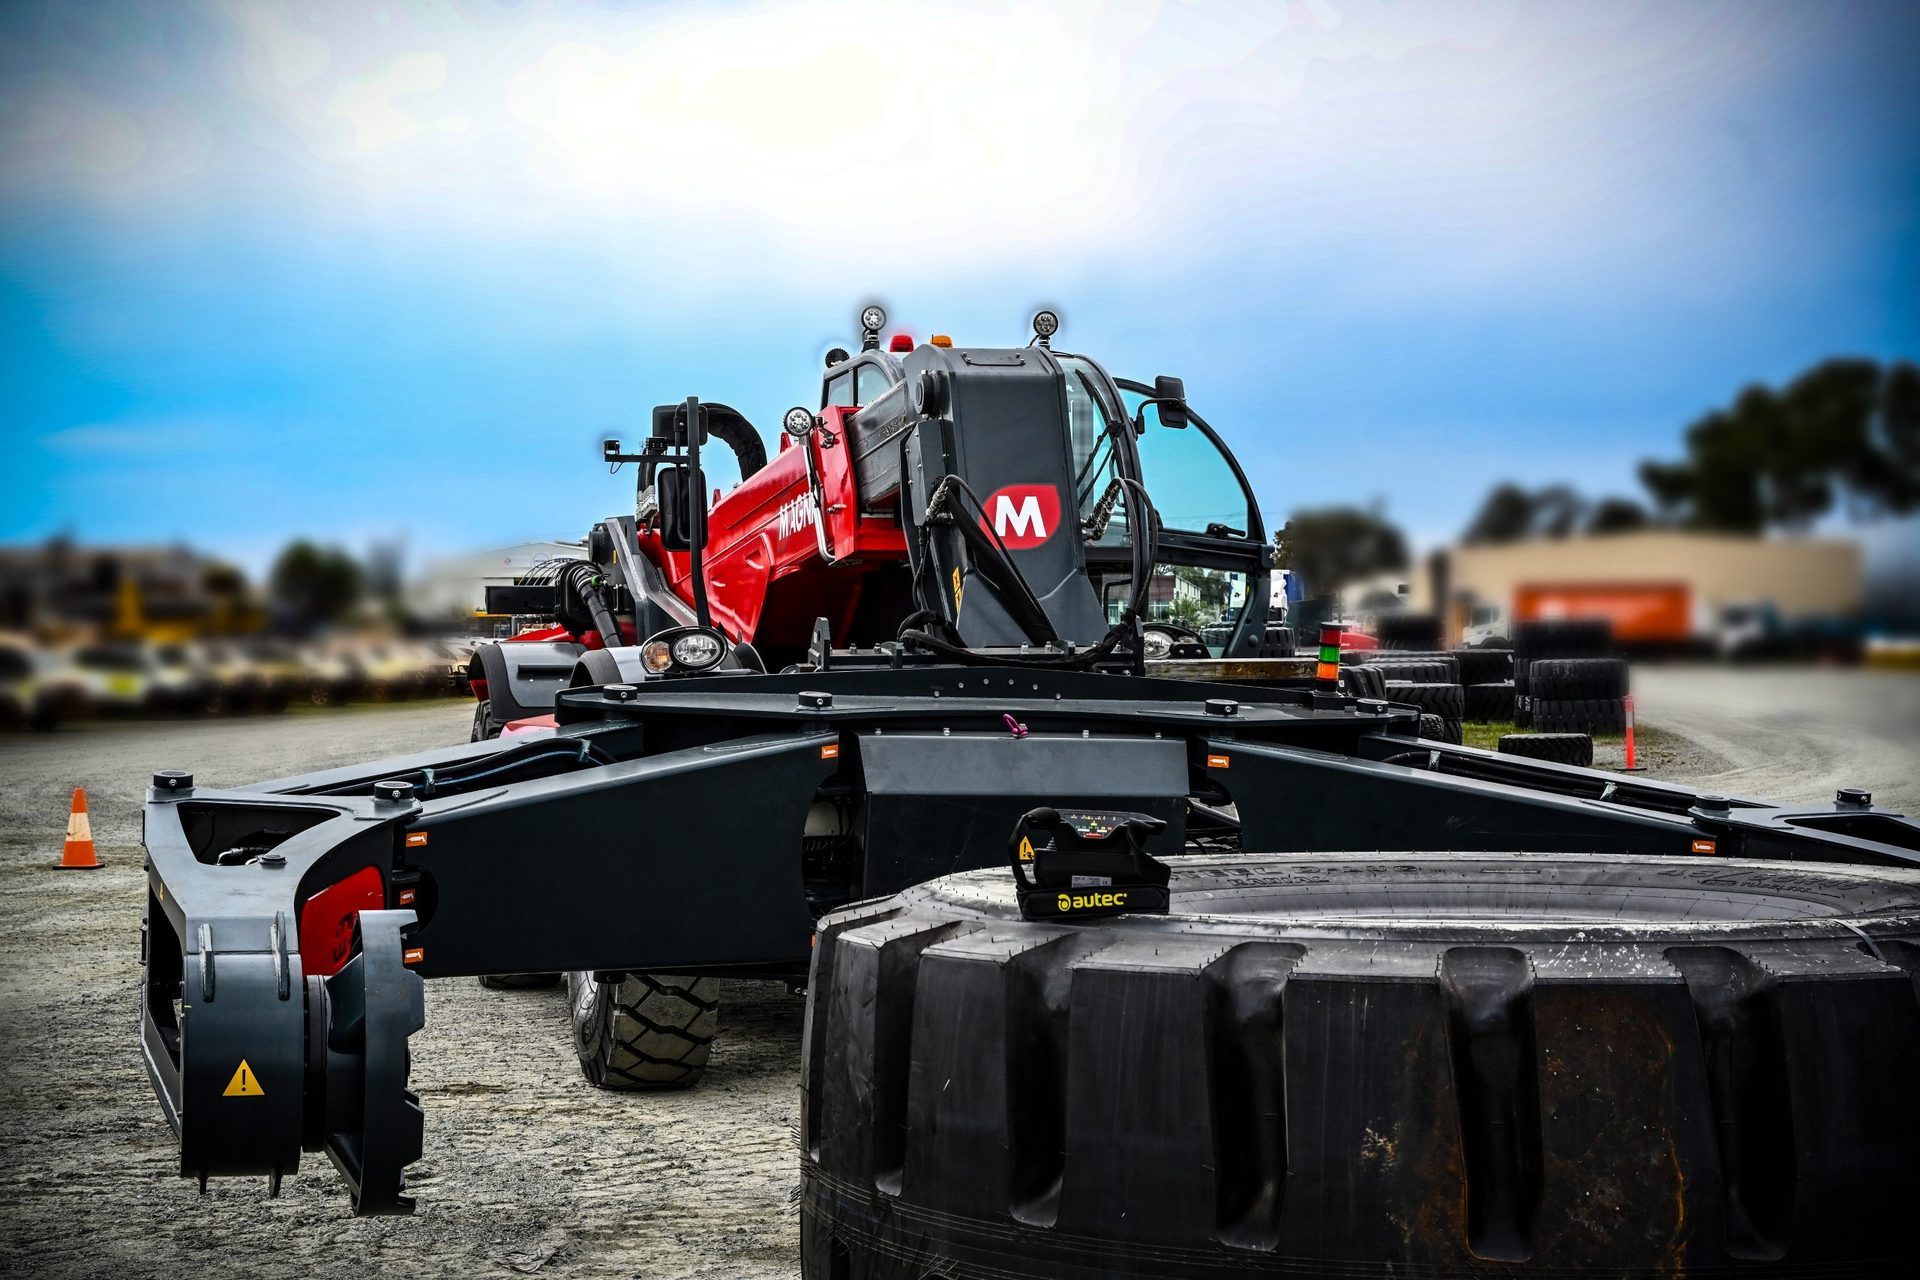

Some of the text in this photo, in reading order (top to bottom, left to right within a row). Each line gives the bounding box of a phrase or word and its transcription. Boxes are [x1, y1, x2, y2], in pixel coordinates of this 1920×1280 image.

[994, 496, 1047, 537] M
[1228, 875, 1330, 886] RADIAL
[1072, 892, 1126, 909] autec
